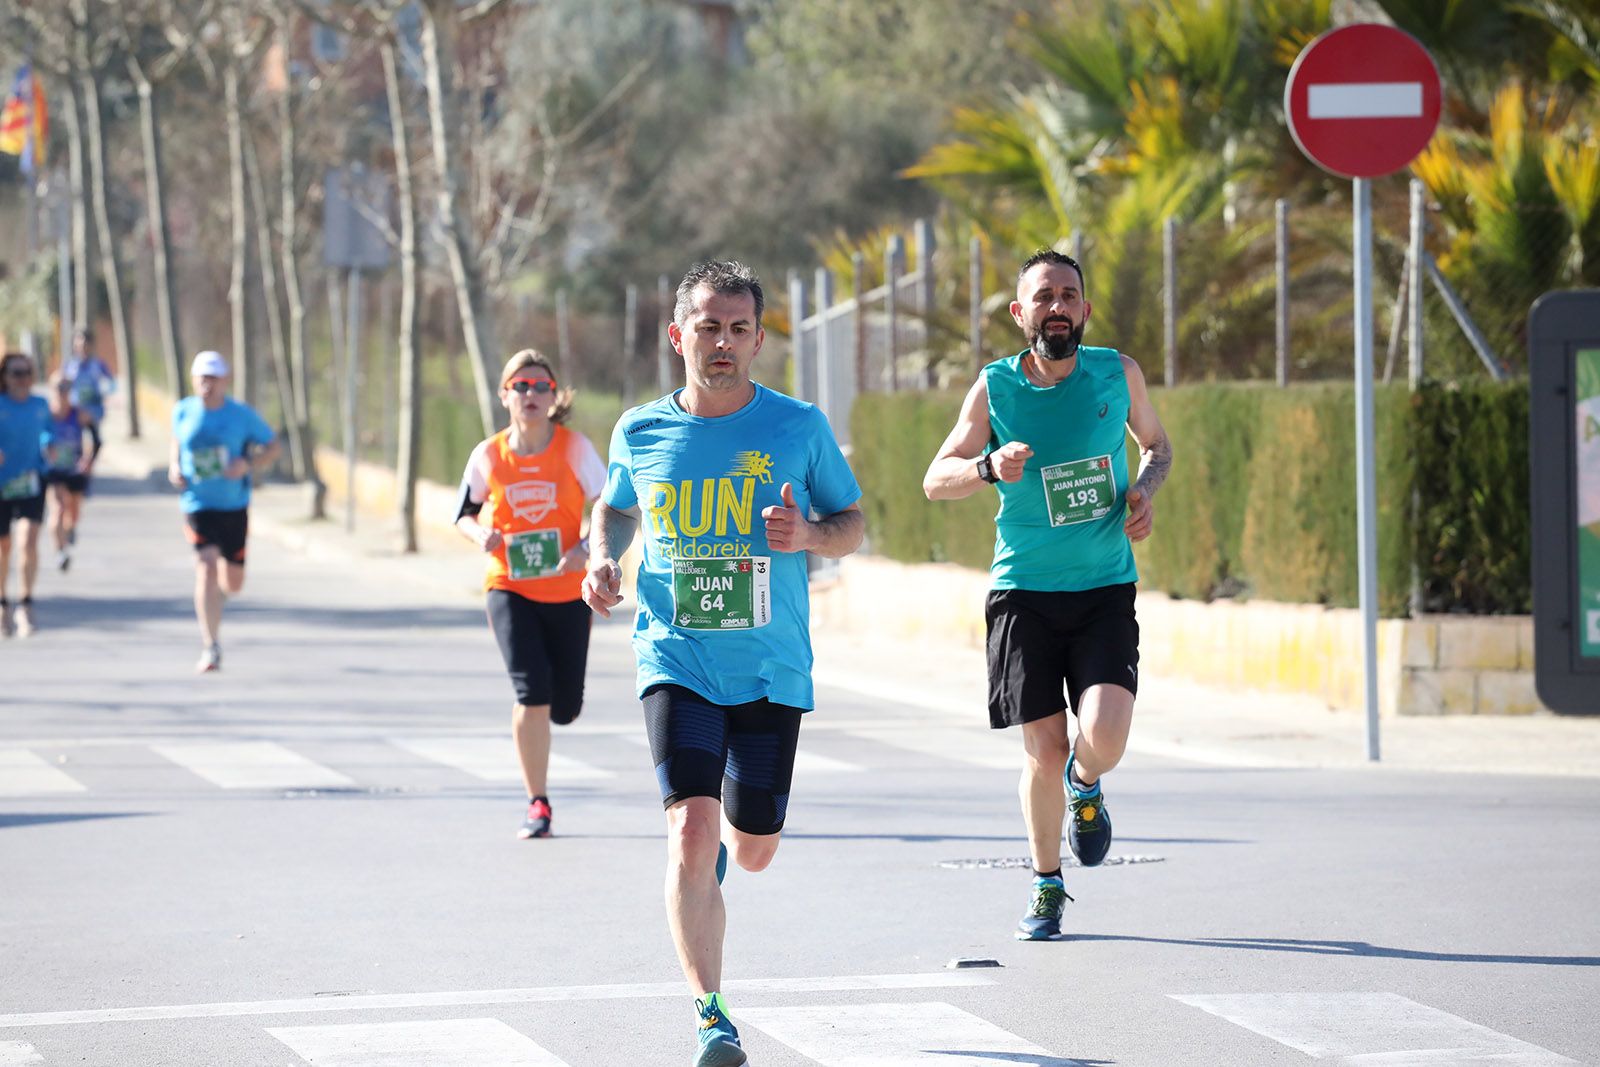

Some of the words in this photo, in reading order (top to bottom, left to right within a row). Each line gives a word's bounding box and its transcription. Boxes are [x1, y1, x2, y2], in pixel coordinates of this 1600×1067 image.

[627, 420, 653, 436] luanvi
[1053, 481, 1073, 491] JUAN
[1074, 474, 1107, 487] ANTONIO
[1067, 488, 1098, 508] 193
[649, 478, 756, 538] RUN
[525, 552, 542, 567] 72
[757, 562, 766, 574] 64
[691, 576, 733, 591] JUAN
[700, 594, 725, 612] 64
